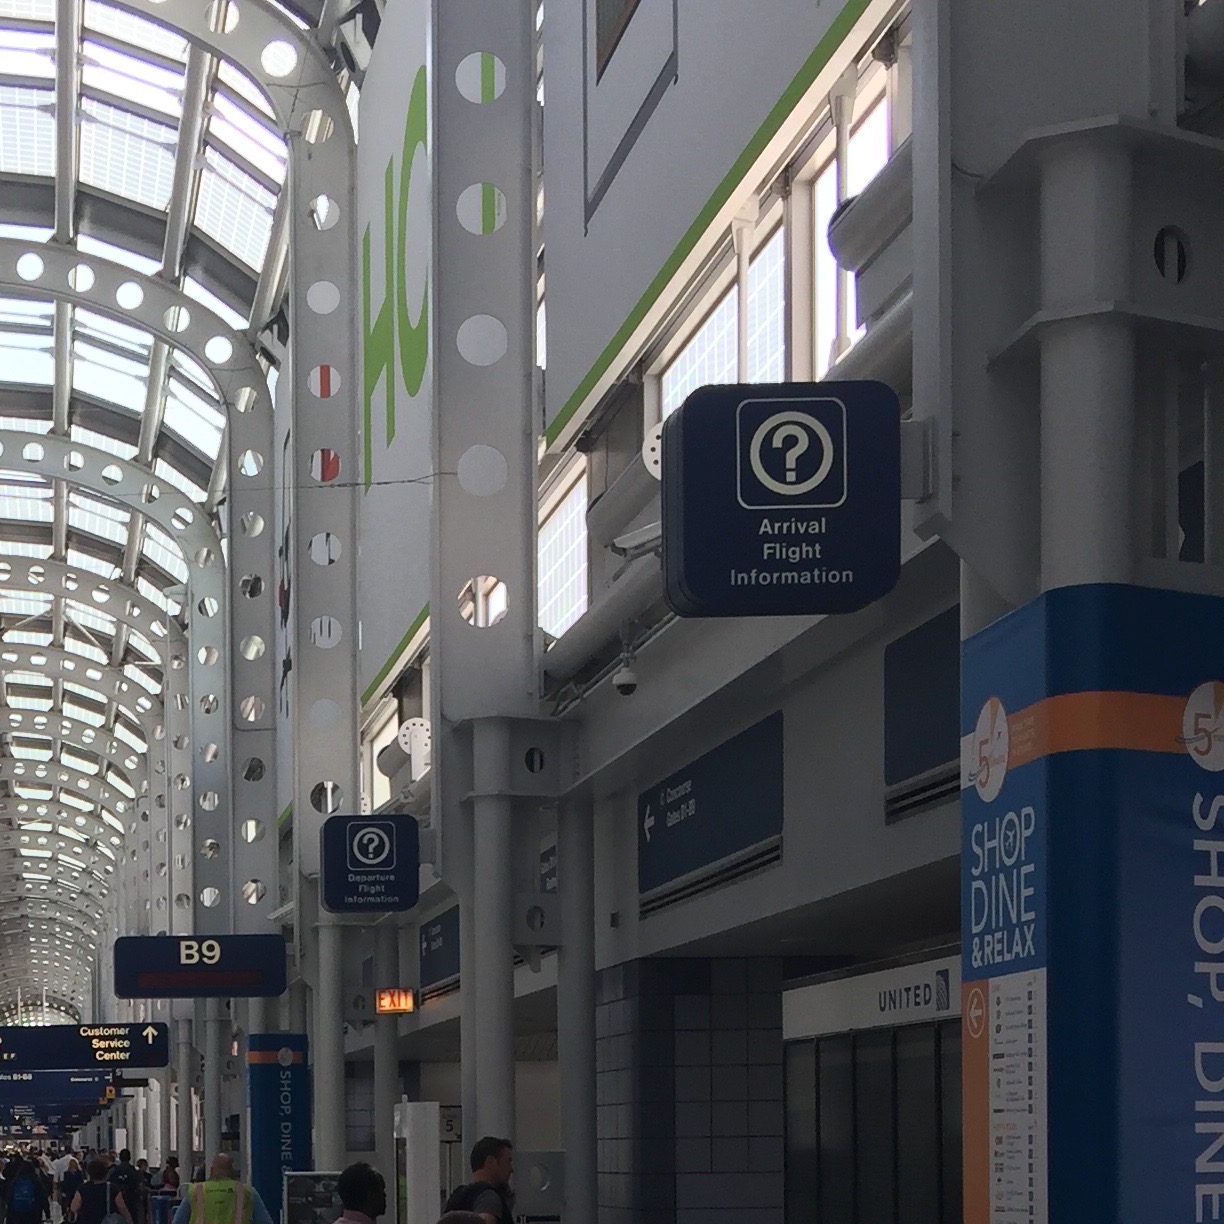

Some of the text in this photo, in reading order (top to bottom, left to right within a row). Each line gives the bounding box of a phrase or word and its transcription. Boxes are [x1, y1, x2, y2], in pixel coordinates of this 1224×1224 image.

[759, 517, 826, 535] Arrival
[763, 543, 822, 563] Flight
[730, 567, 854, 586] Information
[1194, 713, 1212, 756] 5
[971, 806, 1036, 877] SHOP
[347, 873, 396, 882] Departure
[344, 895, 399, 903] Information
[358, 884, 385, 894] Flight
[971, 863, 1036, 935] DINE
[1188, 792, 1224, 1009] SHOP,
[179, 940, 222, 966] B9
[971, 923, 1036, 969] &RELAX
[378, 990, 409, 1008] EXIT
[878, 983, 932, 1012] UNITED
[80, 1026, 130, 1036] Customer
[91, 1039, 131, 1049] Service
[95, 1051, 131, 1061] Center
[279, 1070, 292, 1116] SHOP,
[446, 1119, 454, 1132] 5
[1194, 1041, 1224, 1222] DINE
[280, 1122, 293, 1161] DINE
